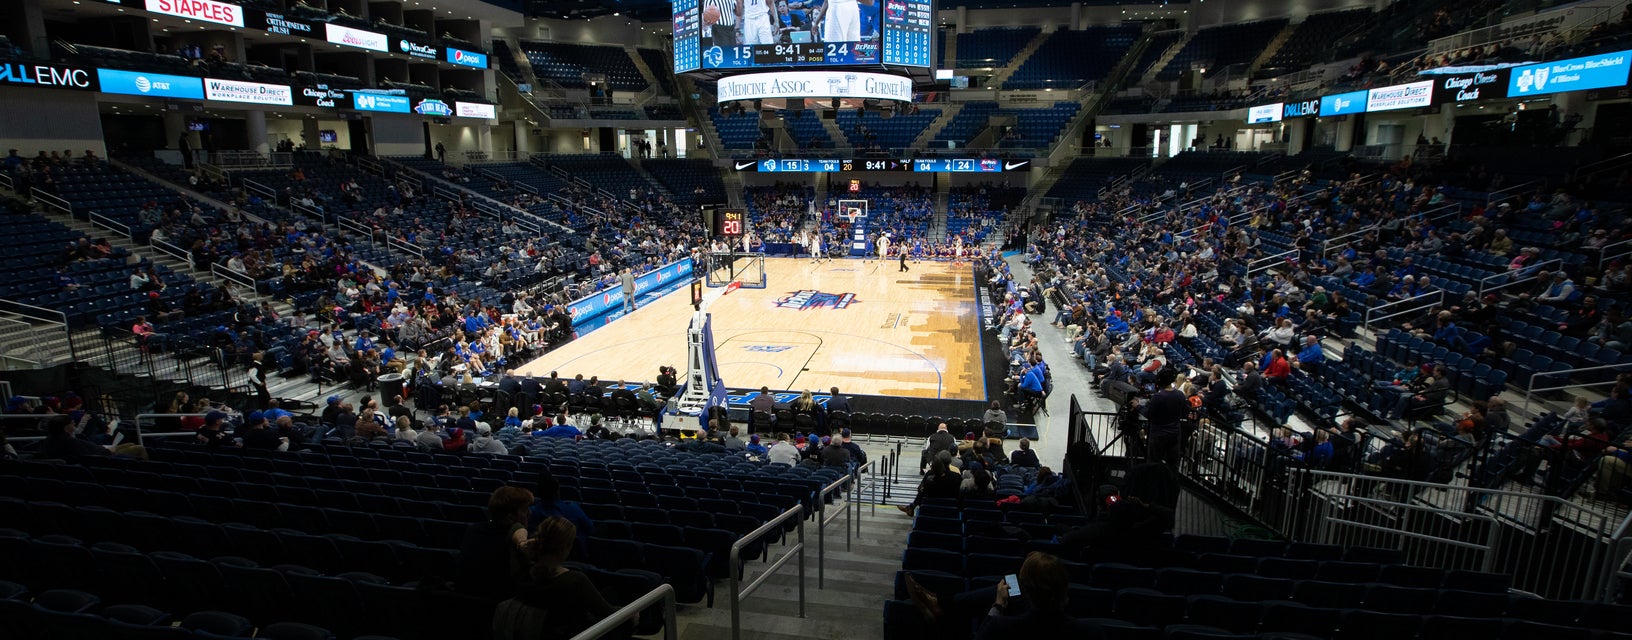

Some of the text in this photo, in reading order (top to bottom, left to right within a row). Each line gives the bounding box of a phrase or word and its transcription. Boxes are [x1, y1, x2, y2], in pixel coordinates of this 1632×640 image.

[159, 0, 234, 22] STAPLES
[272, 26, 290, 35] RUSH
[362, 37, 378, 47] LIGHT
[410, 42, 436, 55] NovaCare
[733, 46, 751, 59] 15
[775, 44, 800, 55] 9:41
[827, 44, 848, 56] 24
[463, 55, 480, 64] pepsi
[1552, 56, 1623, 73] BlueCross BlueShield
[35, 66, 89, 88] EMC
[1445, 77, 1473, 90] Chicago
[1558, 74, 1580, 83] Illinois
[211, 82, 284, 96] WAREHOUSE DIRECT
[303, 88, 327, 99] Chicago
[728, 82, 766, 96] MEDICINE
[771, 78, 813, 93] ASSOC.
[865, 78, 898, 96] GURNEE
[1371, 87, 1427, 100] WAREHOUSE DIRECT
[1456, 88, 1480, 101] Coach
[317, 99, 334, 107] Coach
[866, 161, 886, 169] 9:41
[958, 162, 970, 170] 24
[724, 221, 738, 234] 20
[662, 272, 672, 280] pepsi
[638, 281, 649, 290] pepsi
[580, 302, 593, 315] pepsi
